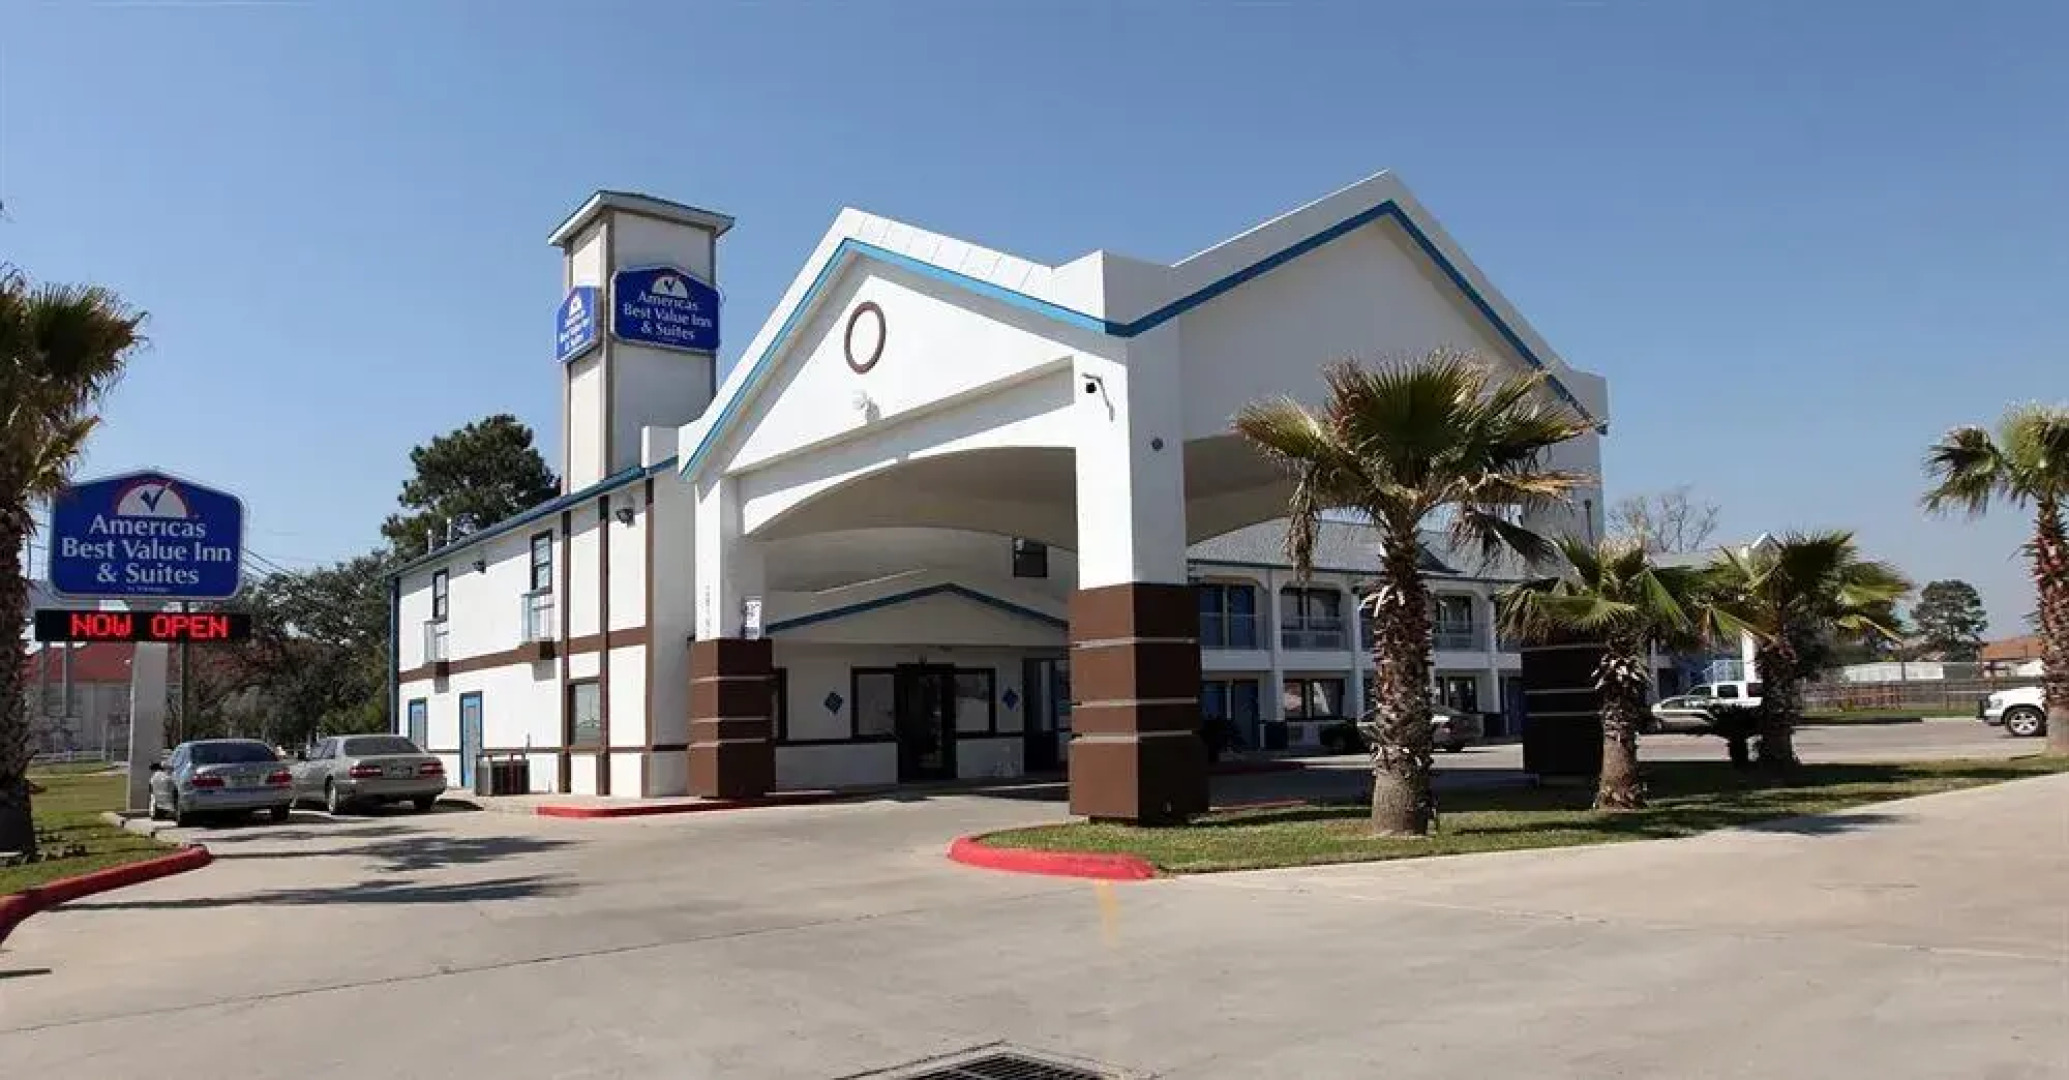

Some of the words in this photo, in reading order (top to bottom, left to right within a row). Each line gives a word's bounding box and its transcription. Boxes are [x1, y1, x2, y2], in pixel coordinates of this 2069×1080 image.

[637, 290, 698, 311] Americas
[623, 302, 650, 319] Best
[654, 307, 690, 326] Value
[691, 314, 712, 328] Inn
[641, 321, 652, 333] &
[656, 322, 695, 340] Suites
[88, 514, 206, 538] Americas
[61, 537, 116, 559] Best
[121, 539, 187, 561] Value
[194, 542, 231, 562] Inn
[96, 563, 117, 583] &
[126, 562, 200, 584] Suites
[70, 613, 132, 636] NOW
[151, 615, 229, 638] OPEN
